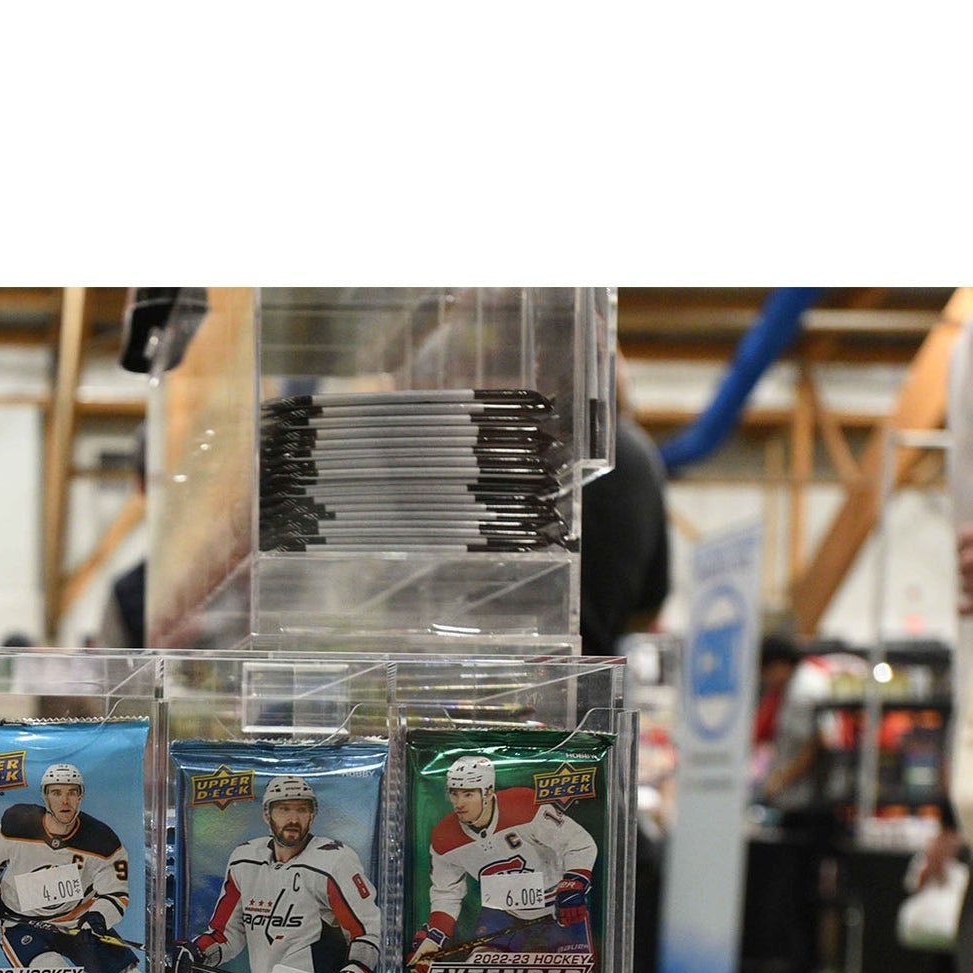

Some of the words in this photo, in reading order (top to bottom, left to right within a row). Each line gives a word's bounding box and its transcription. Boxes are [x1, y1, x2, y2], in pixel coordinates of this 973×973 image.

[196, 776, 250, 791] UPPER
[538, 774, 591, 788] UPPER
[504, 831, 523, 850] C
[43, 881, 73, 901] 4.00
[292, 872, 301, 893] C
[506, 888, 536, 907] 6.00
[473, 954, 530, 965] 2022-23
[533, 954, 589, 965] HOCKEY
